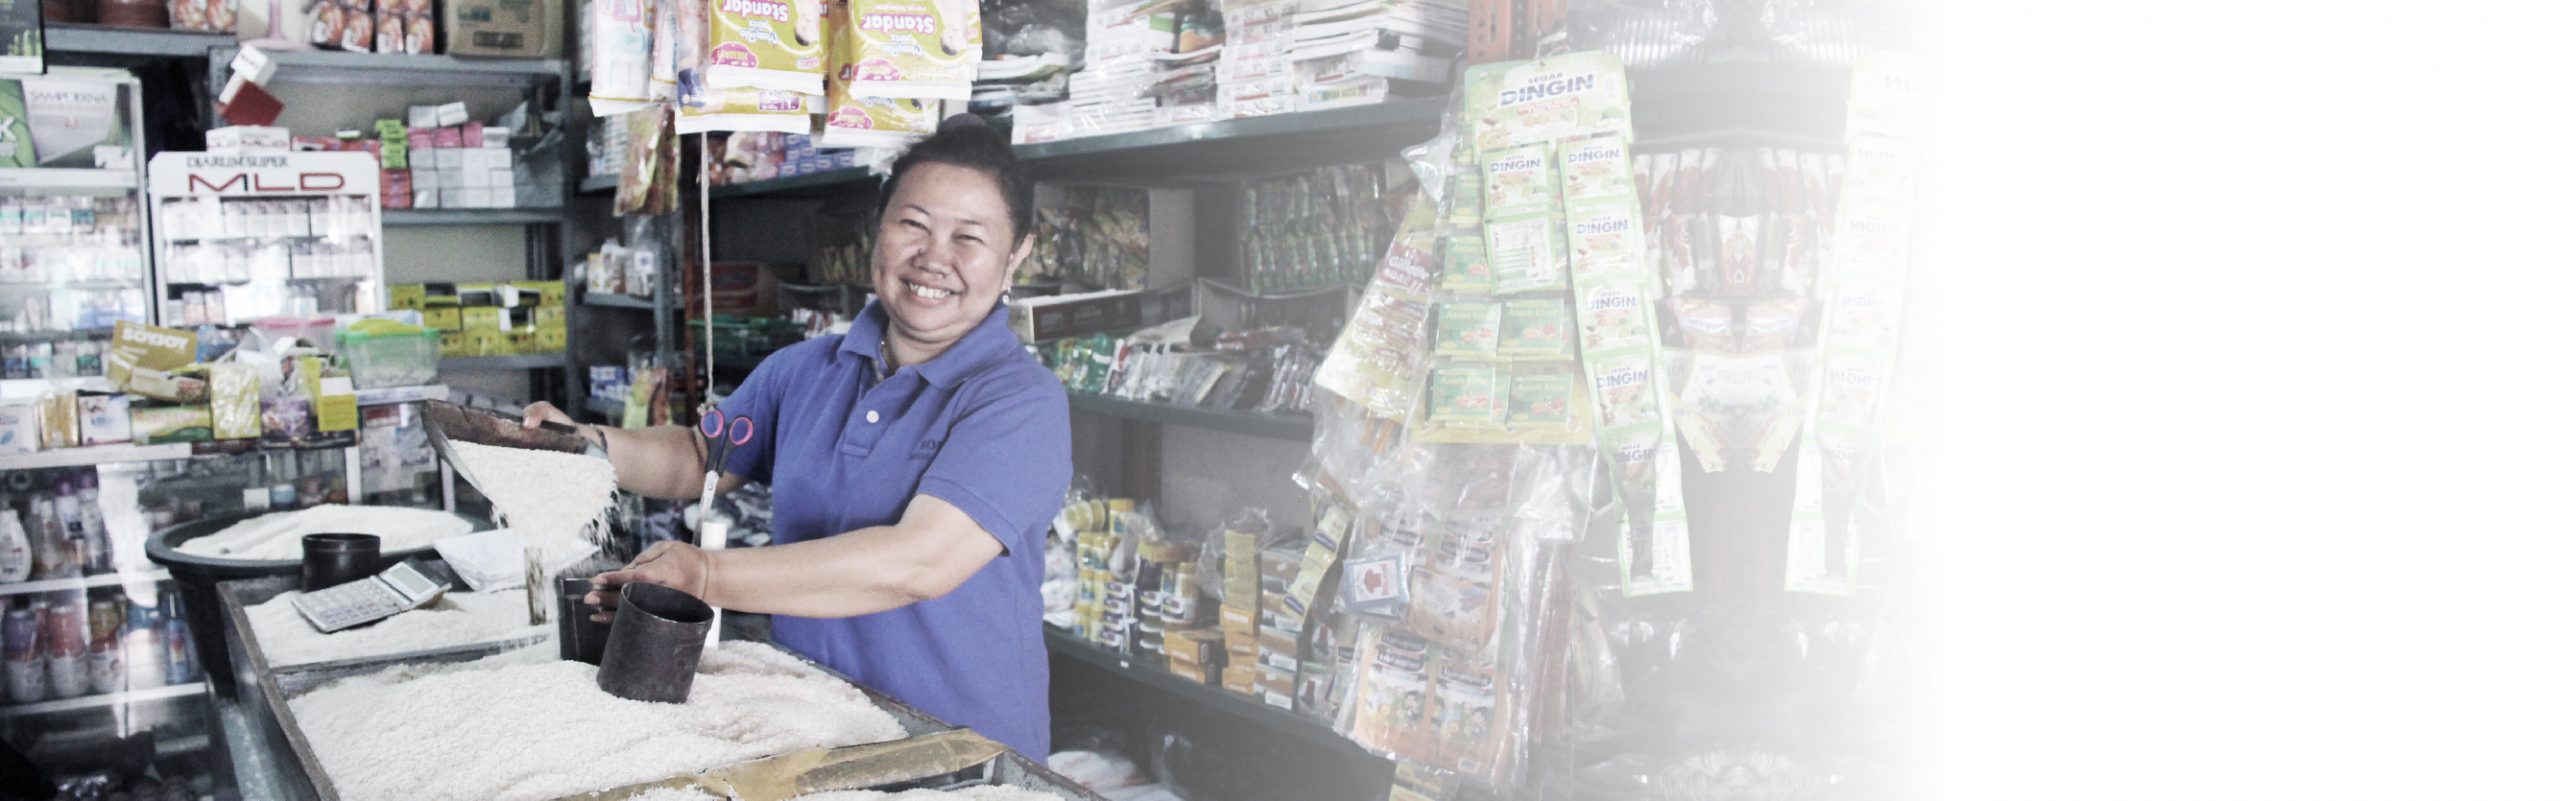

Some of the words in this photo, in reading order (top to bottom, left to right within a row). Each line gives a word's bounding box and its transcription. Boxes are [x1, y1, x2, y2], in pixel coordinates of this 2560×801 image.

[722, 0, 789, 22] Standar
[862, 14, 935, 34] Standar
[1500, 74, 1594, 106] DINGIN
[1489, 158, 1541, 173] DINGIN
[1567, 149, 1620, 164] DINGIN
[188, 173, 345, 193] MLD
[1576, 219, 1629, 236] DINGIN
[1595, 369, 1648, 389] DINGIN
